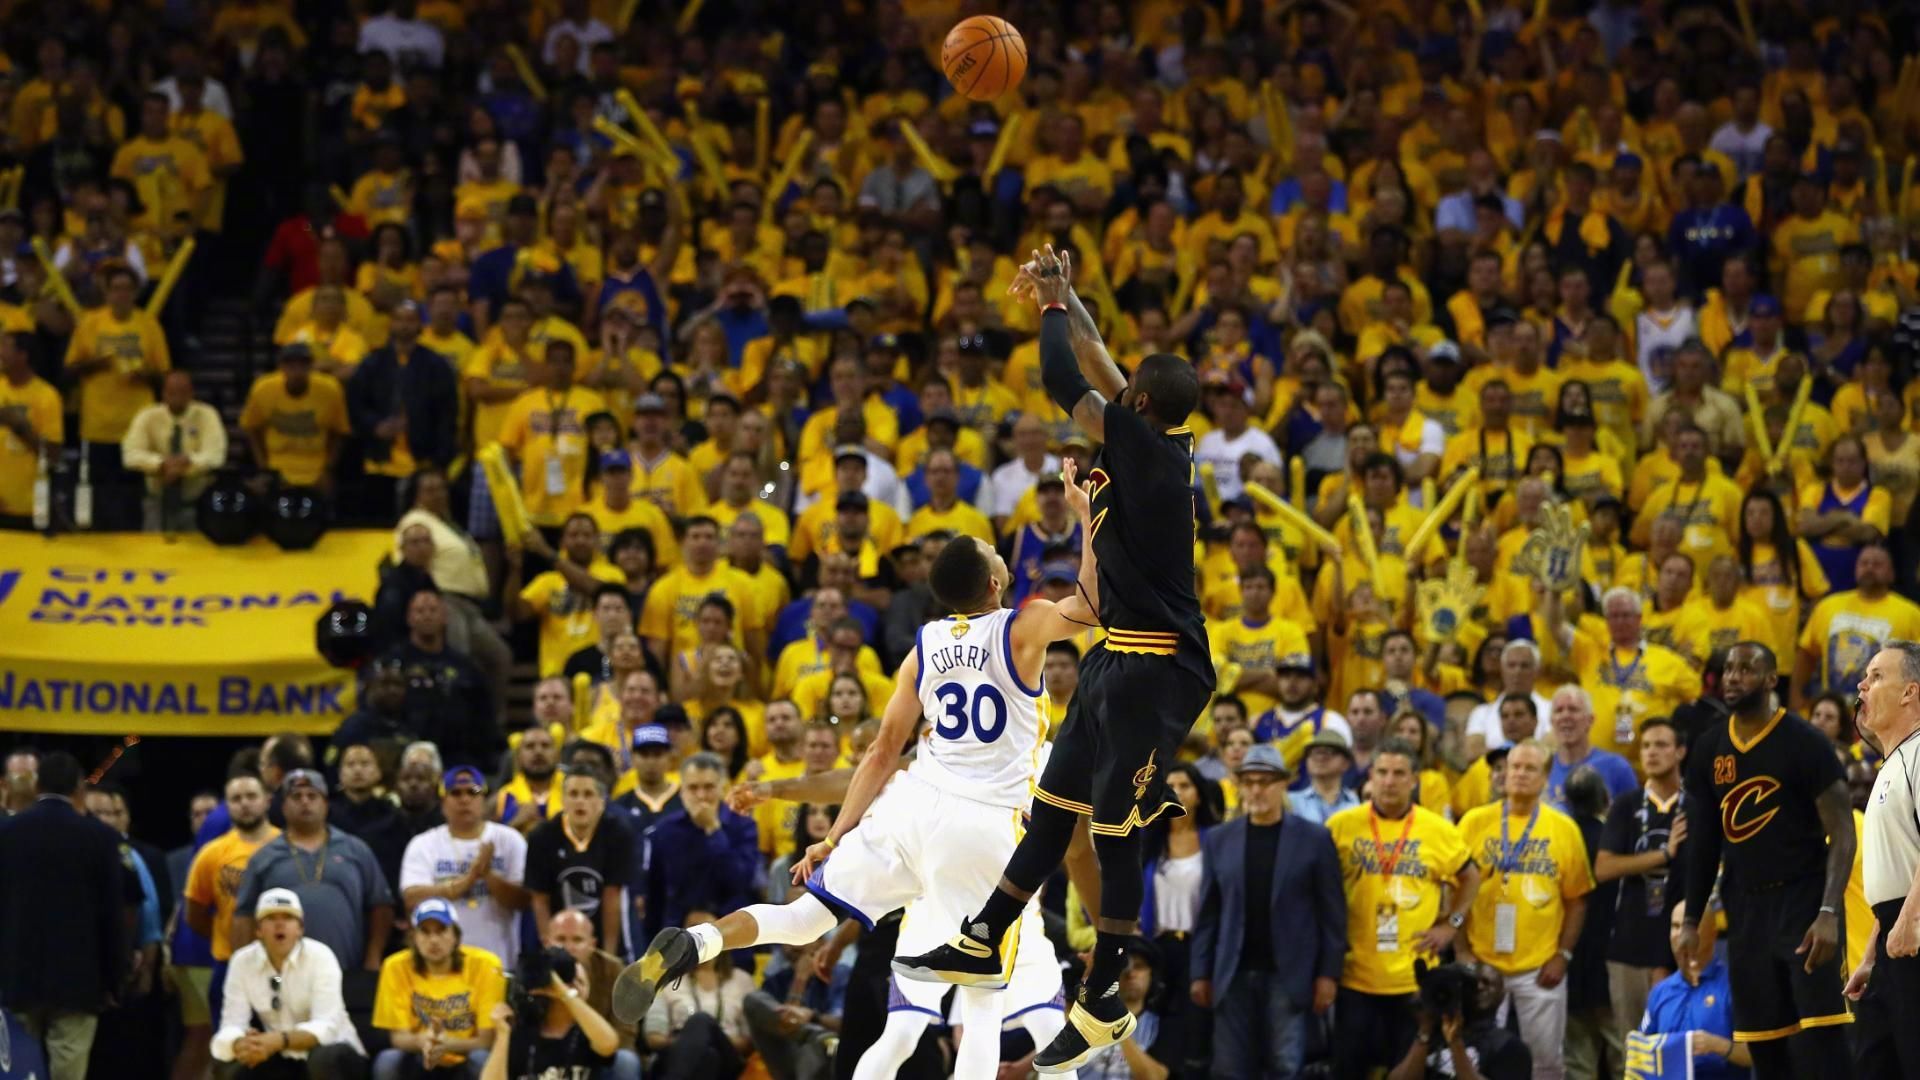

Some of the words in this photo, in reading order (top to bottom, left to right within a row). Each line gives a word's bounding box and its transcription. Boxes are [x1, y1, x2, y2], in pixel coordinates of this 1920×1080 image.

[49, 567, 176, 583] CITY
[39, 587, 361, 612] NATIONAL
[29, 608, 208, 627] BANK
[931, 645, 990, 674] CURRY
[218, 676, 345, 716] BANK
[934, 682, 1007, 744] 30
[1714, 755, 1737, 784] 23
